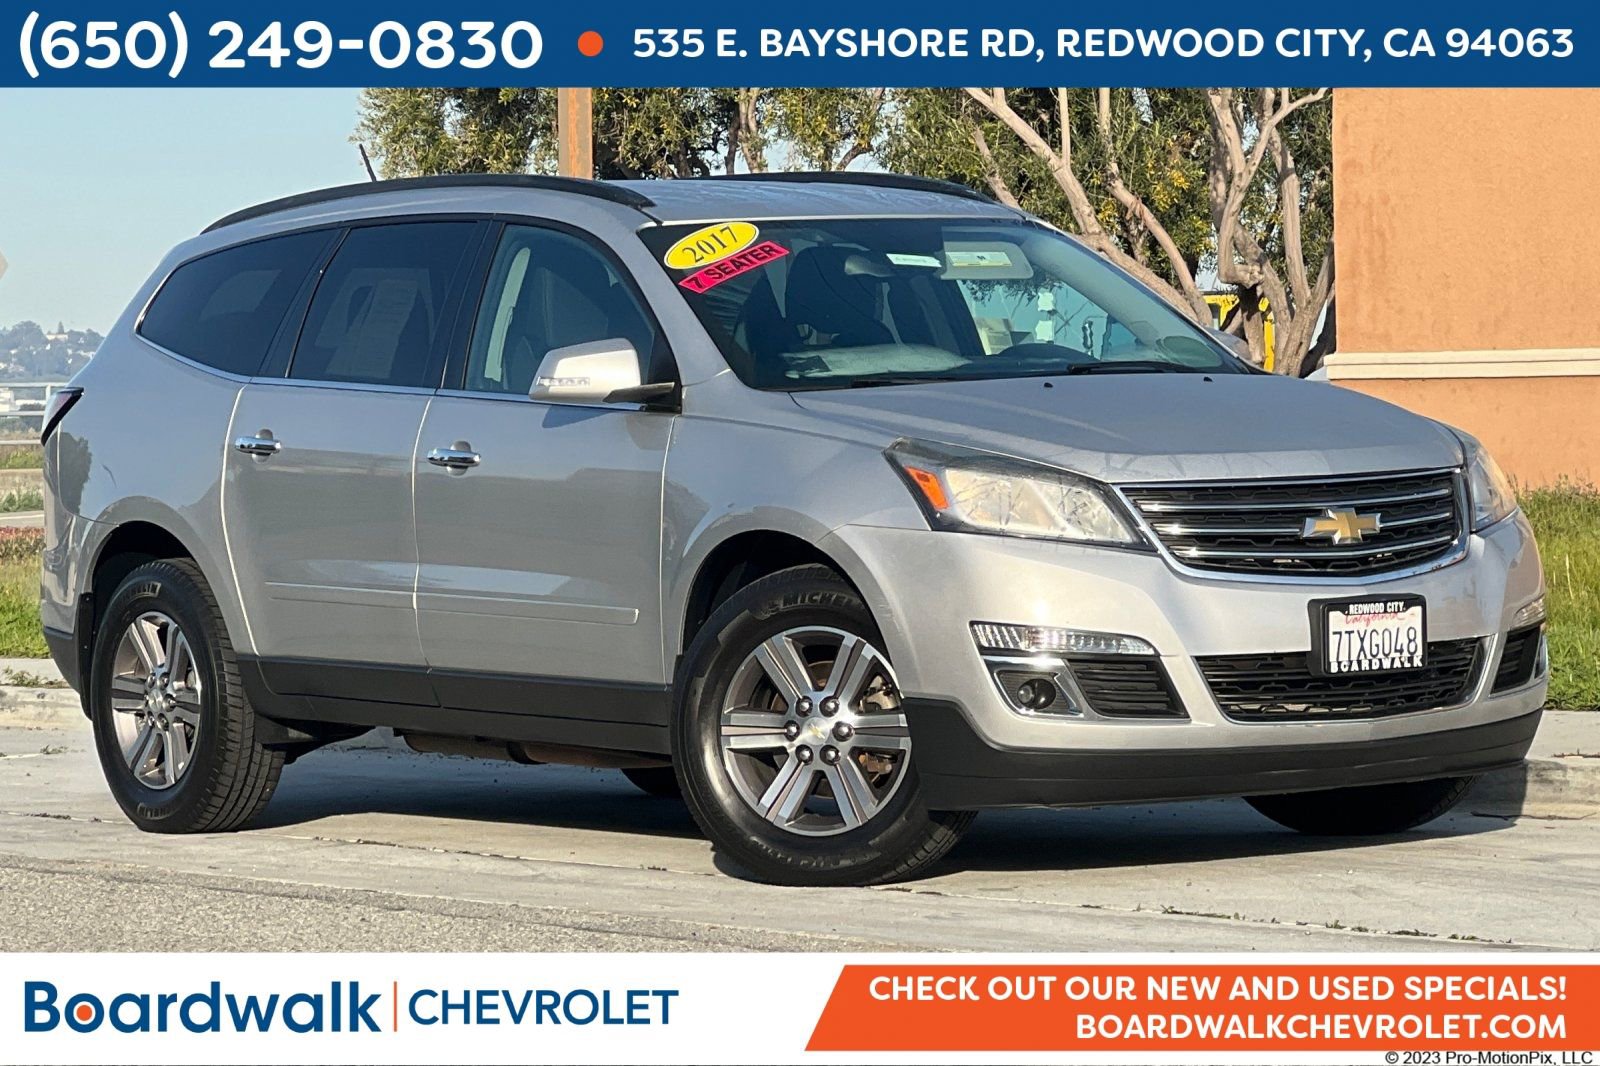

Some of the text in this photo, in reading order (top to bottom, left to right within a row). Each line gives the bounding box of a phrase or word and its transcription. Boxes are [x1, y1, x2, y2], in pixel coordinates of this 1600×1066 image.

[682, 226, 738, 263] 2017
[688, 244, 780, 289] 7 SEATER
[1349, 601, 1405, 615] REDWOOD CITY
[1332, 626, 1418, 662] 7TXG048
